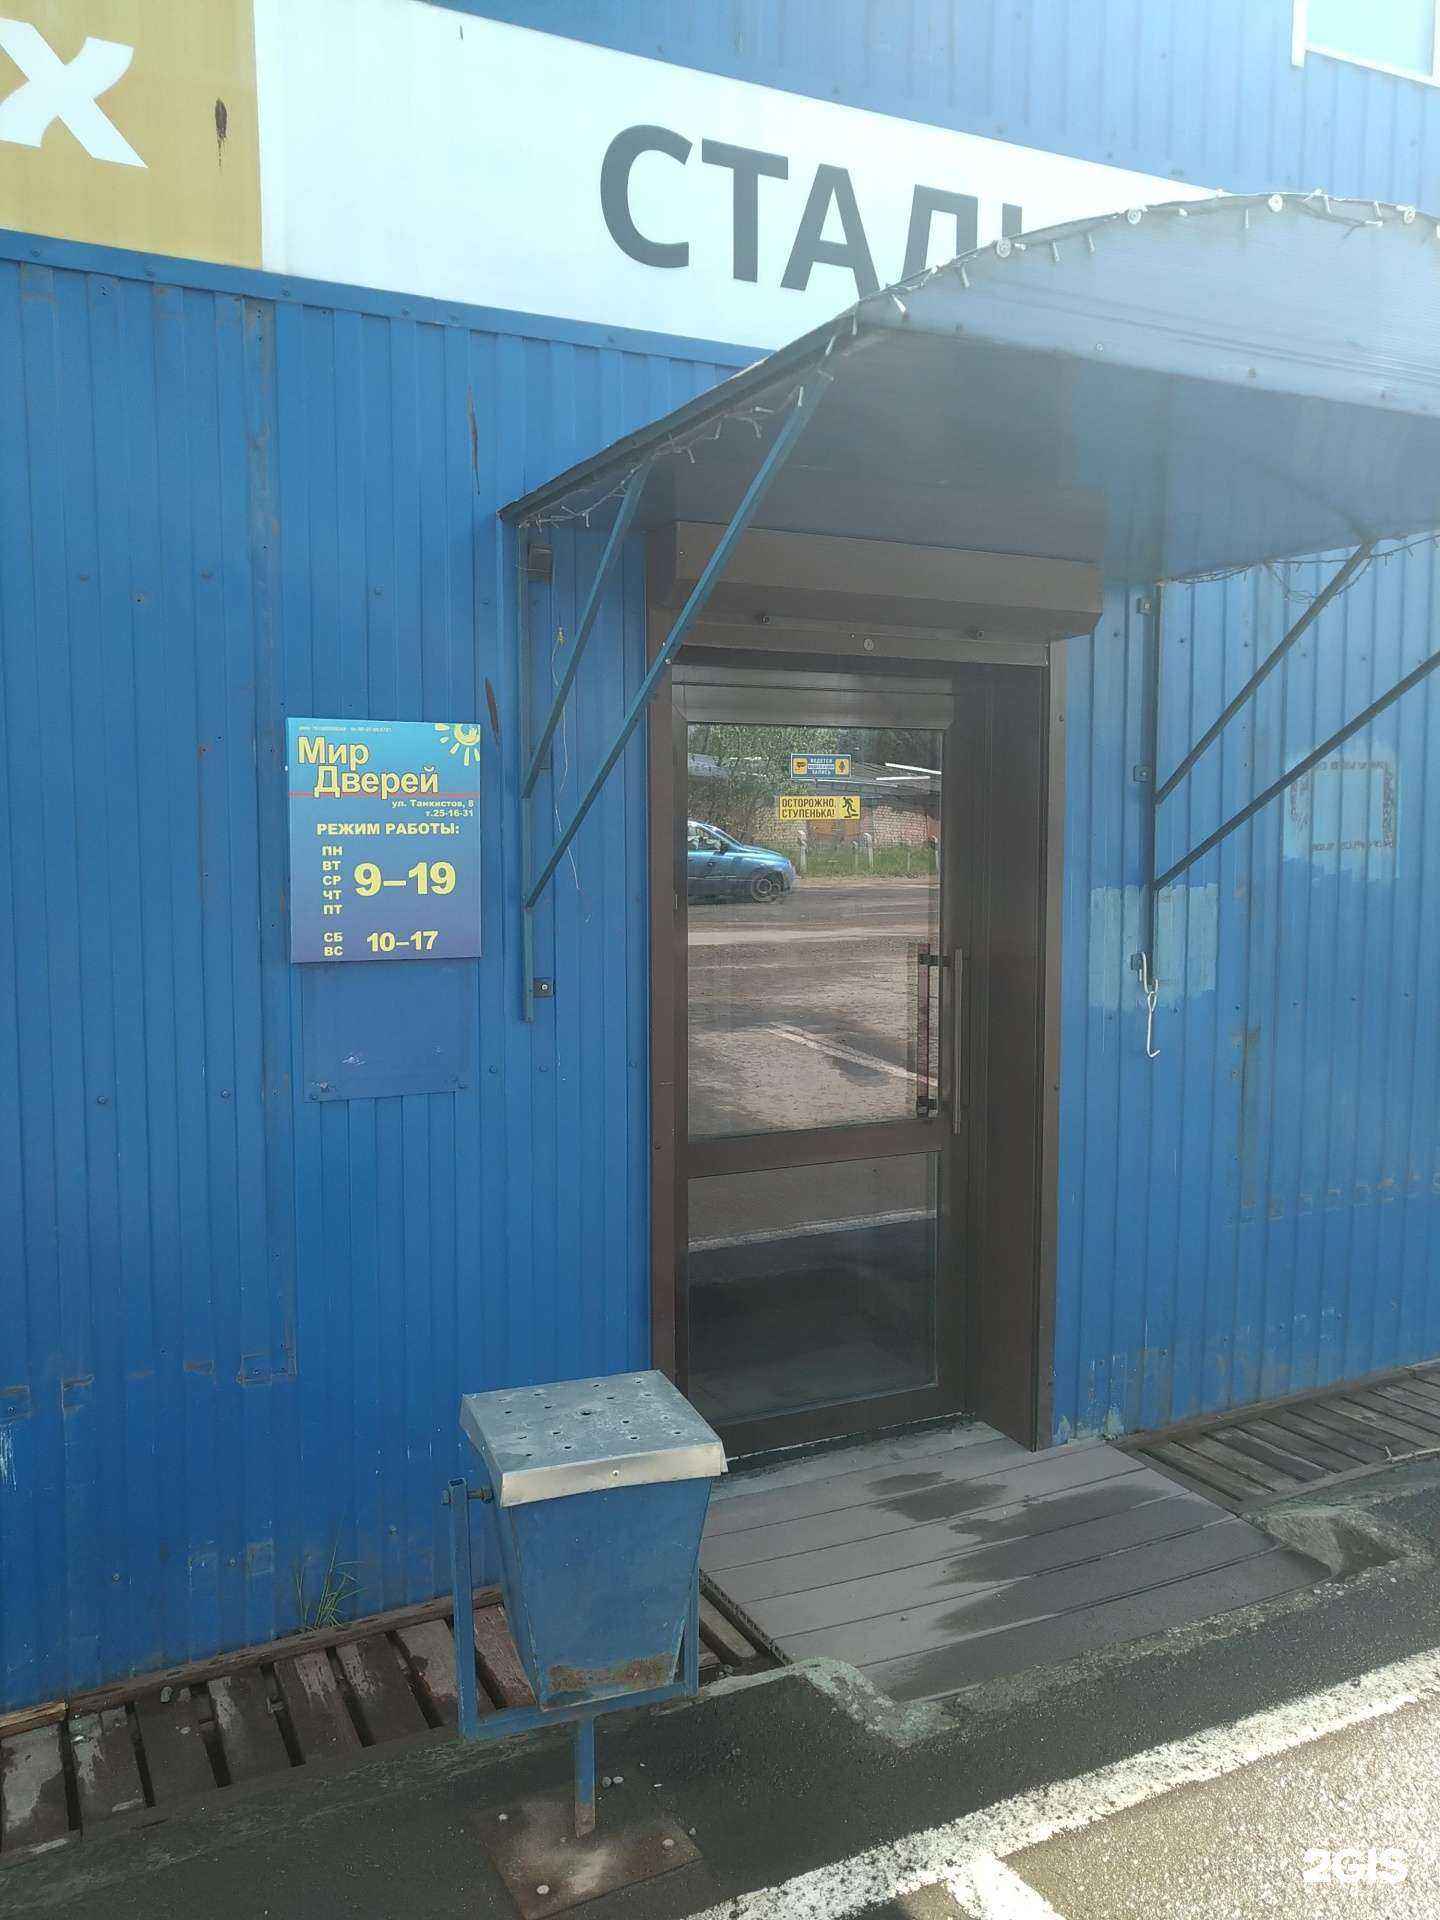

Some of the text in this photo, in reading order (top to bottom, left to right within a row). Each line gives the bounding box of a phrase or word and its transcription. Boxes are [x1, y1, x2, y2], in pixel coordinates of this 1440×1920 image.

[298, 736, 369, 771] Мир
[313, 765, 439, 800] Дверей
[392, 801, 407, 809] ул.
[782, 798, 837, 808] ОСТОРОЖНО,
[782, 809, 835, 818] СТУПЕНЬКА!
[316, 822, 460, 835] РЕЖИМ РАБОТЫ:
[322, 846, 343, 856] ПН
[322, 861, 341, 871] ВТ
[322, 875, 342, 886] СР
[323, 890, 342, 900] ЧТ
[323, 904, 343, 914] ПТ
[323, 932, 343, 943] СБ
[324, 946, 343, 957] ВС
